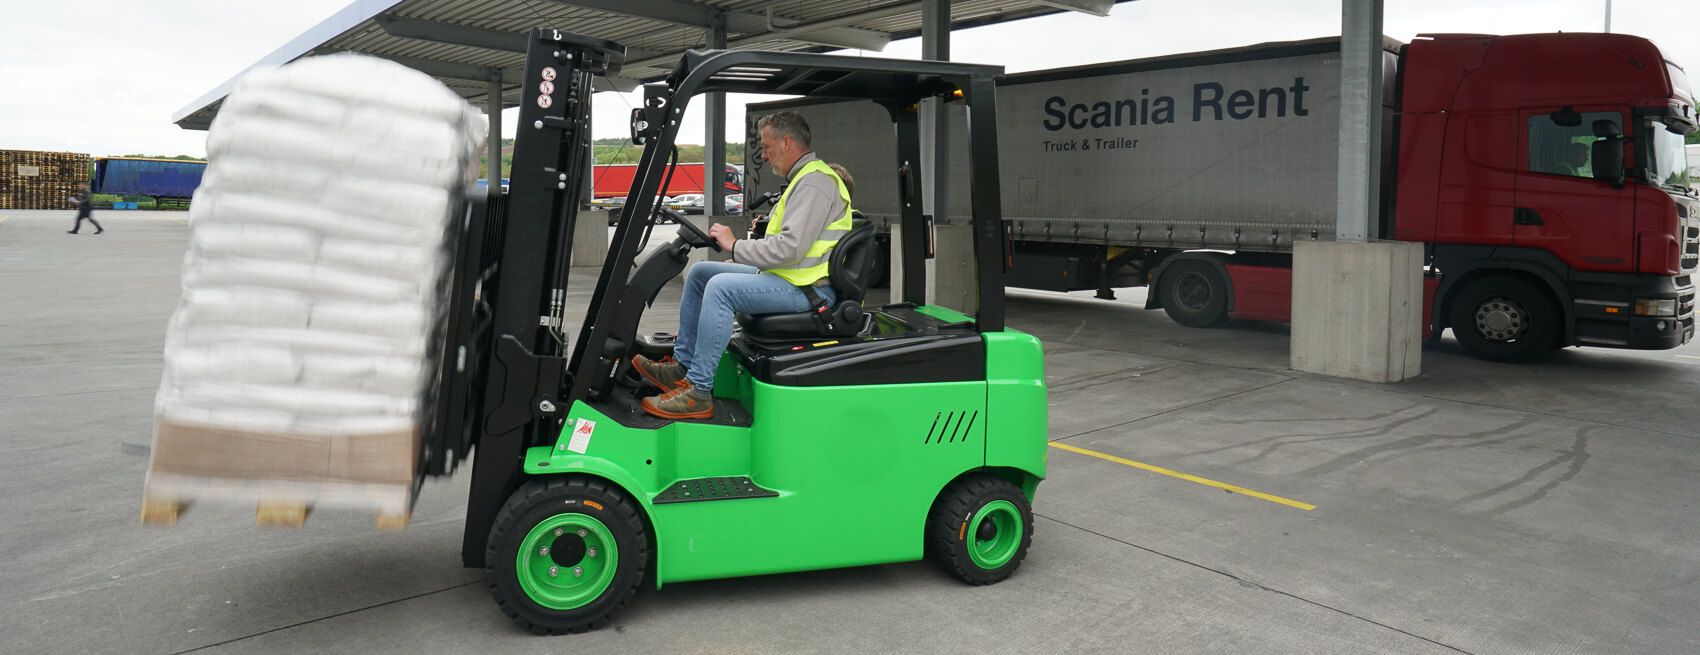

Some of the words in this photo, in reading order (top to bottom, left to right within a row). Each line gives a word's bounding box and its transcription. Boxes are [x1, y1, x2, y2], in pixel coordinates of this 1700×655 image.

[1043, 88, 1175, 131] Scania
[1192, 77, 1310, 122] Rent
[1043, 140, 1077, 152] Truck
[1082, 139, 1090, 151] &
[1095, 138, 1139, 149] Trailer
